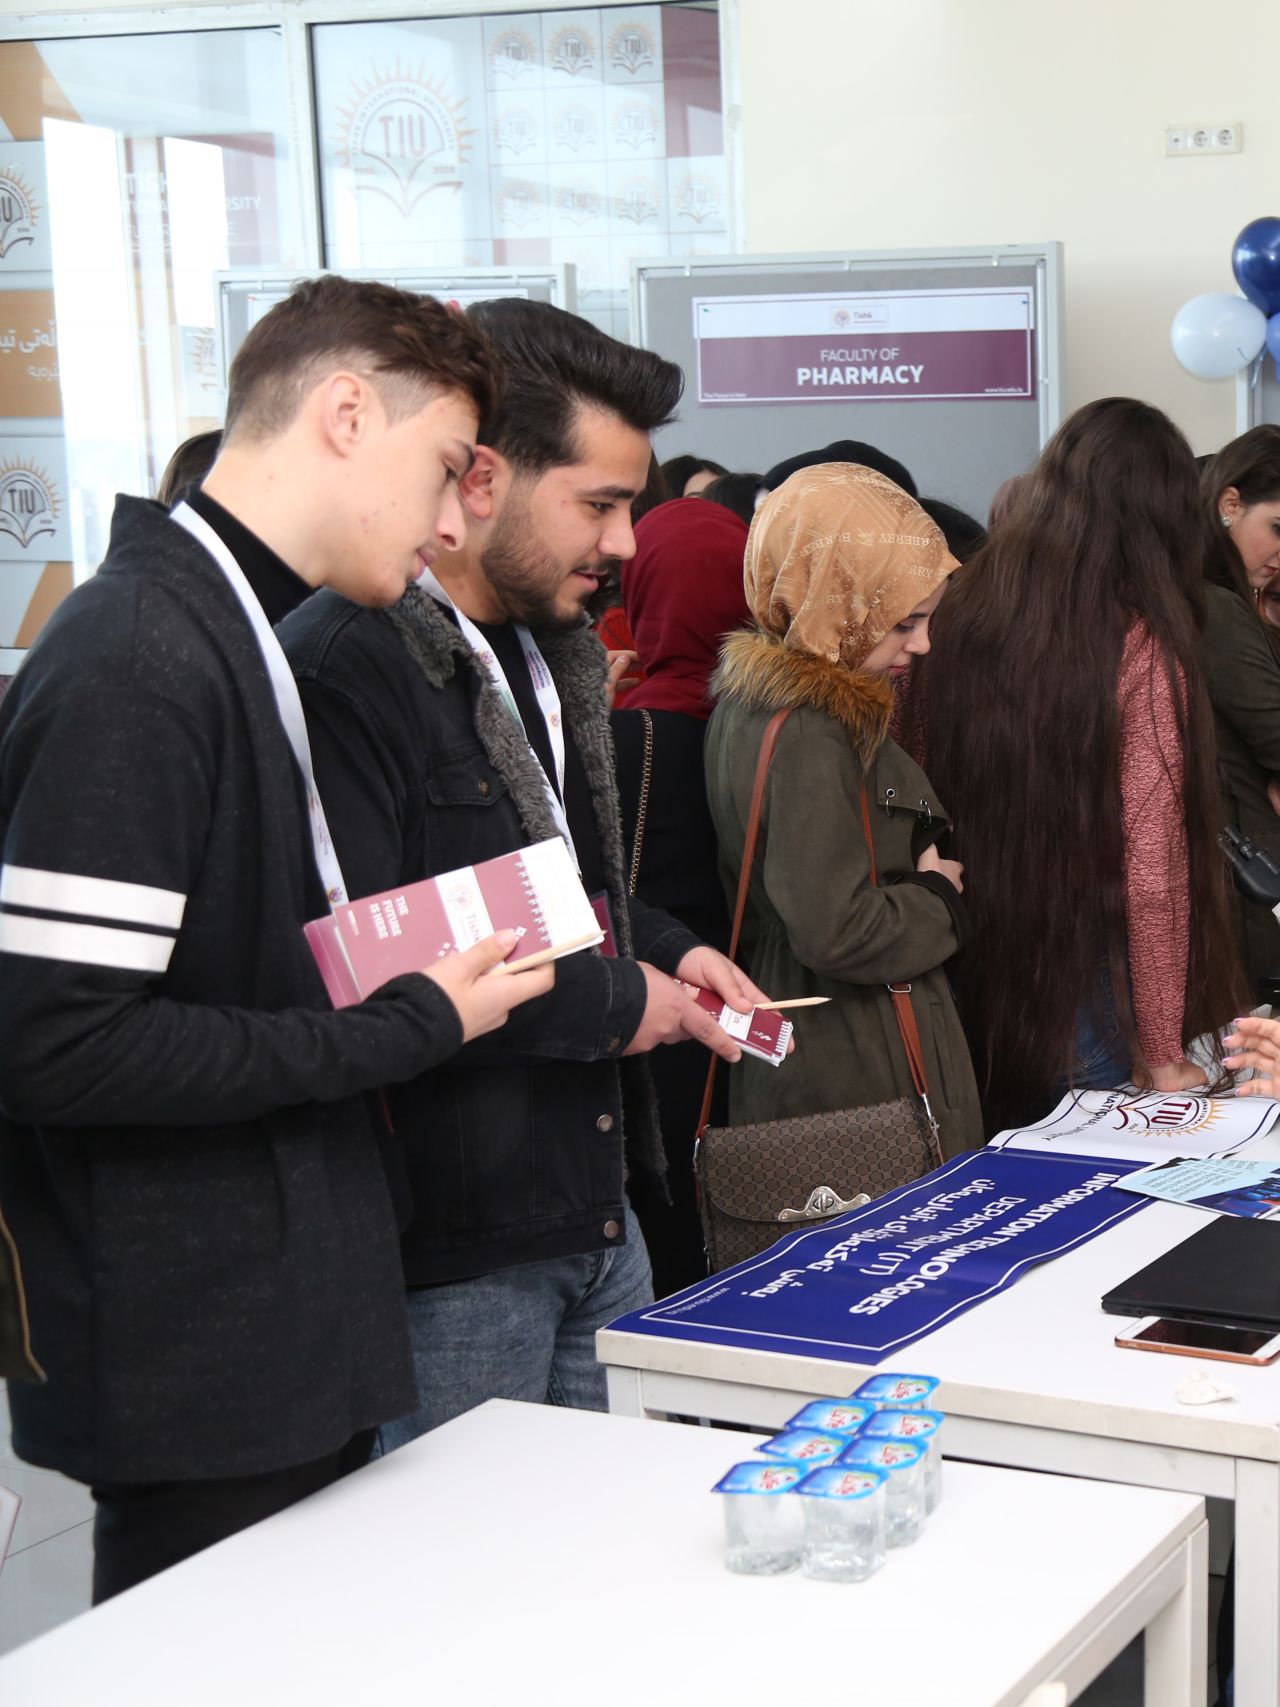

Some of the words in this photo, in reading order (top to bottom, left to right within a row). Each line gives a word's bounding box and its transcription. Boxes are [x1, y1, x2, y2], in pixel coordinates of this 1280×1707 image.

[378, 113, 428, 158] TIU
[820, 350, 876, 363] FACULTY
[880, 347, 900, 361] OF
[796, 365, 925, 386] PHARMACY
[8, 489, 36, 514] TIU
[369, 903, 381, 915] IS
[383, 899, 402, 937] FUTURE
[396, 896, 409, 916] THE
[372, 911, 389, 940] HERE
[1151, 1101, 1192, 1126] TIU
[992, 1172, 1121, 1237] INFORMATION
[896, 1197, 1027, 1252] DEPARTMENT
[848, 1231, 1010, 1316] TECHNOLOGIES
[859, 1252, 911, 1277] (IT)
